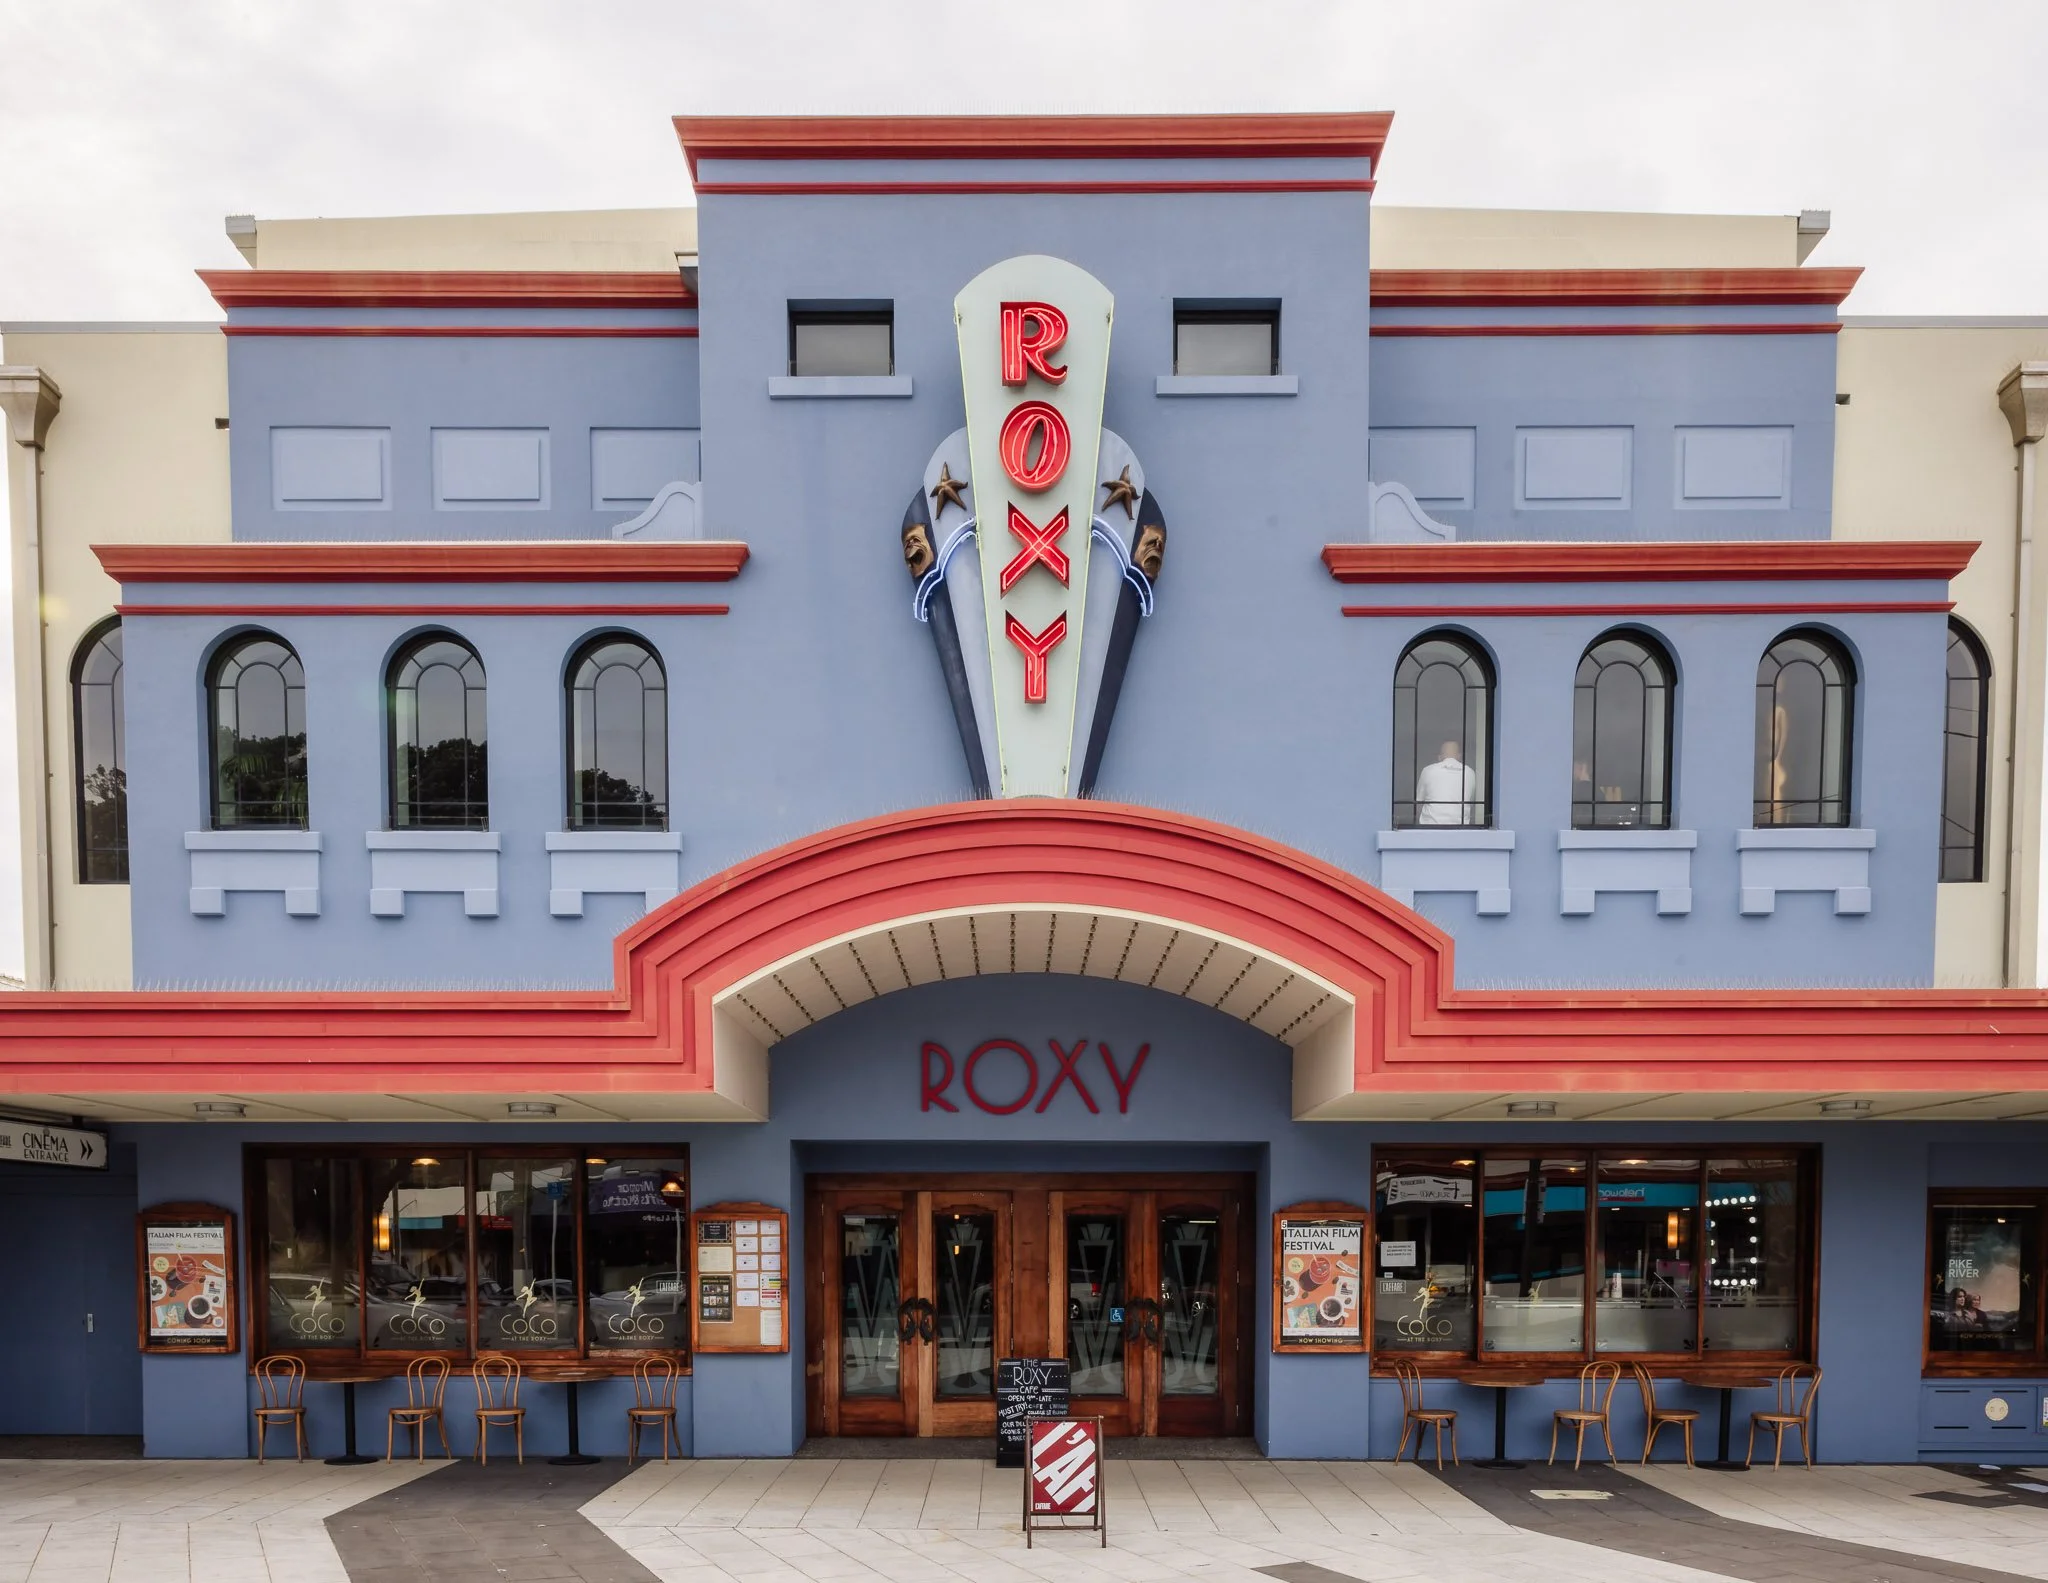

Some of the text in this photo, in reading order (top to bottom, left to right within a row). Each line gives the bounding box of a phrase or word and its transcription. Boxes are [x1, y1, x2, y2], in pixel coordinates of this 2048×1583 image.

[999, 301, 1071, 704] ROXY
[920, 1038, 1151, 1115] ROXY
[24, 1148, 69, 1162] ENTRANCE
[1284, 1228, 1359, 1238] ITALIAN FILM
[1284, 1241, 1335, 1251] FESTIVAL
[1948, 1259, 1973, 1269] PIKE
[1948, 1268, 1980, 1278] RIVER
[1022, 1358, 1039, 1368] THE
[1013, 1366, 1052, 1385] ROXY
[1019, 1385, 1039, 1394] CAFE
[1007, 1394, 1025, 1402] OPEN
[998, 1401, 1028, 1417] MUST TRY!
